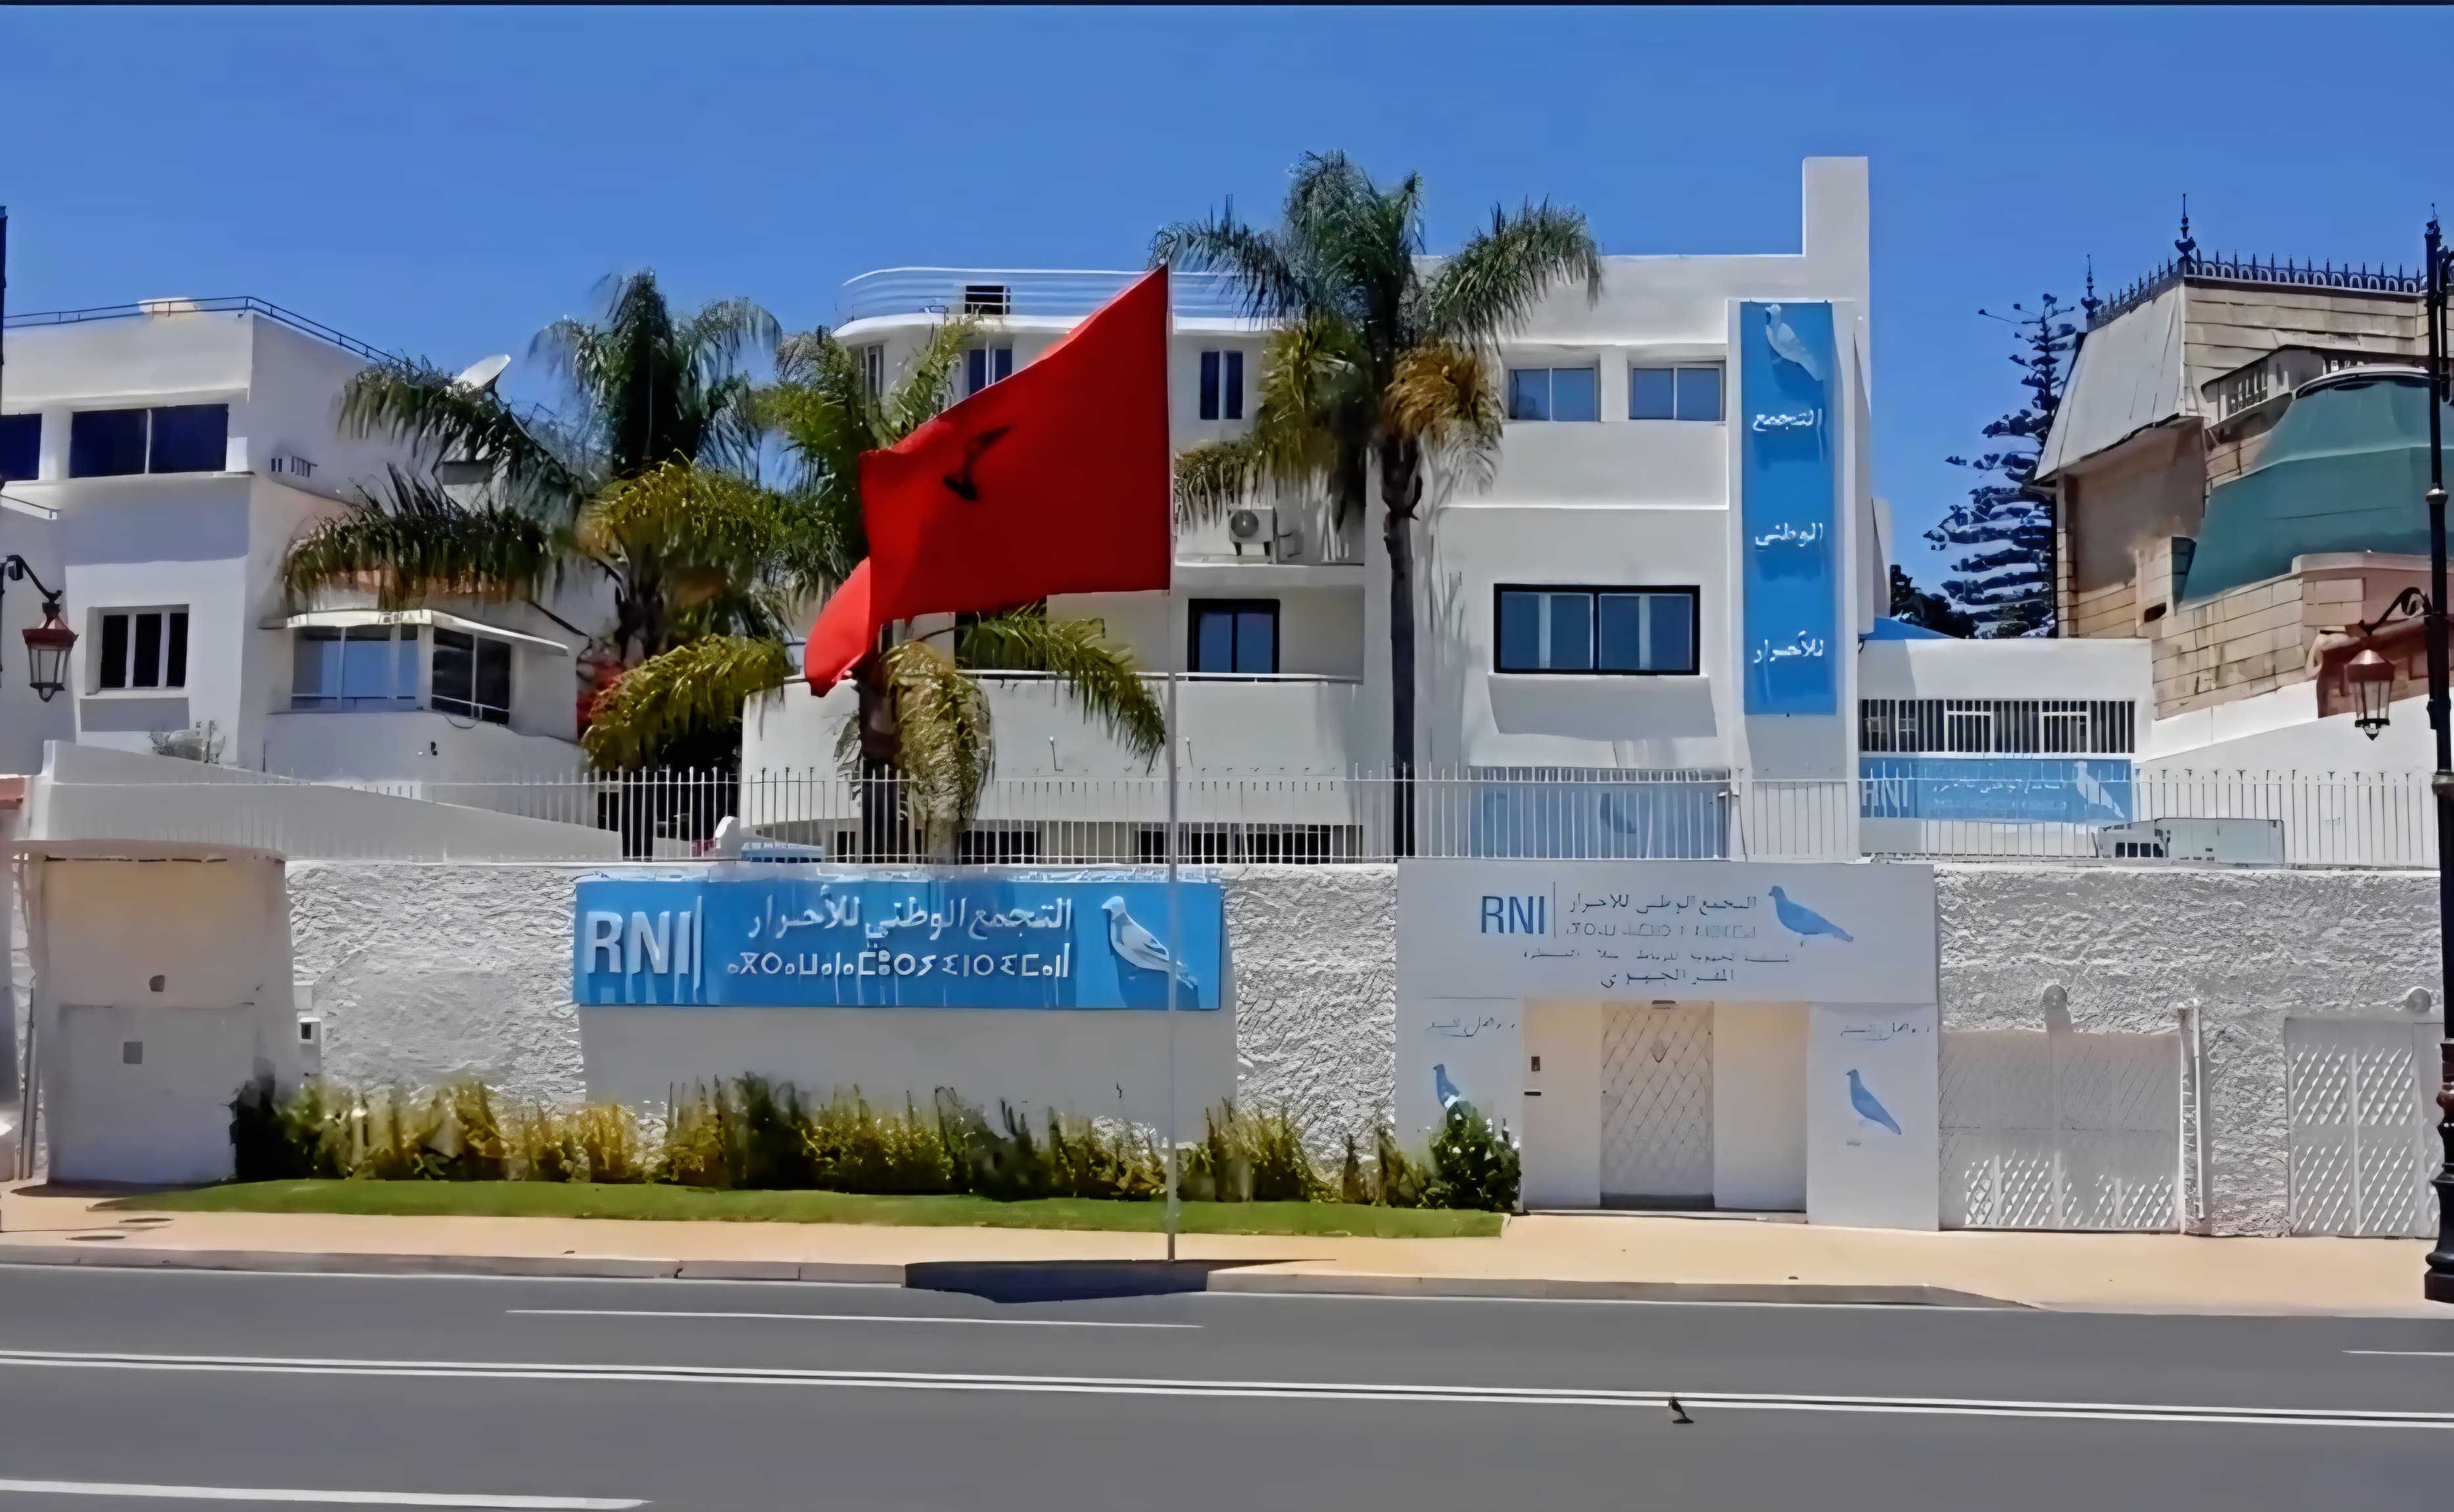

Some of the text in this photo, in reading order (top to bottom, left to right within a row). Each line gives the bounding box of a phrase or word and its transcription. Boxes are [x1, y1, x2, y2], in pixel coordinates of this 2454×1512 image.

[1752, 408, 1822, 432] التجمع
[748, 884, 1072, 948] التجمع الوطني للأحرار
[1481, 896, 1545, 934] RNI
[585, 910, 690, 974] RNI
